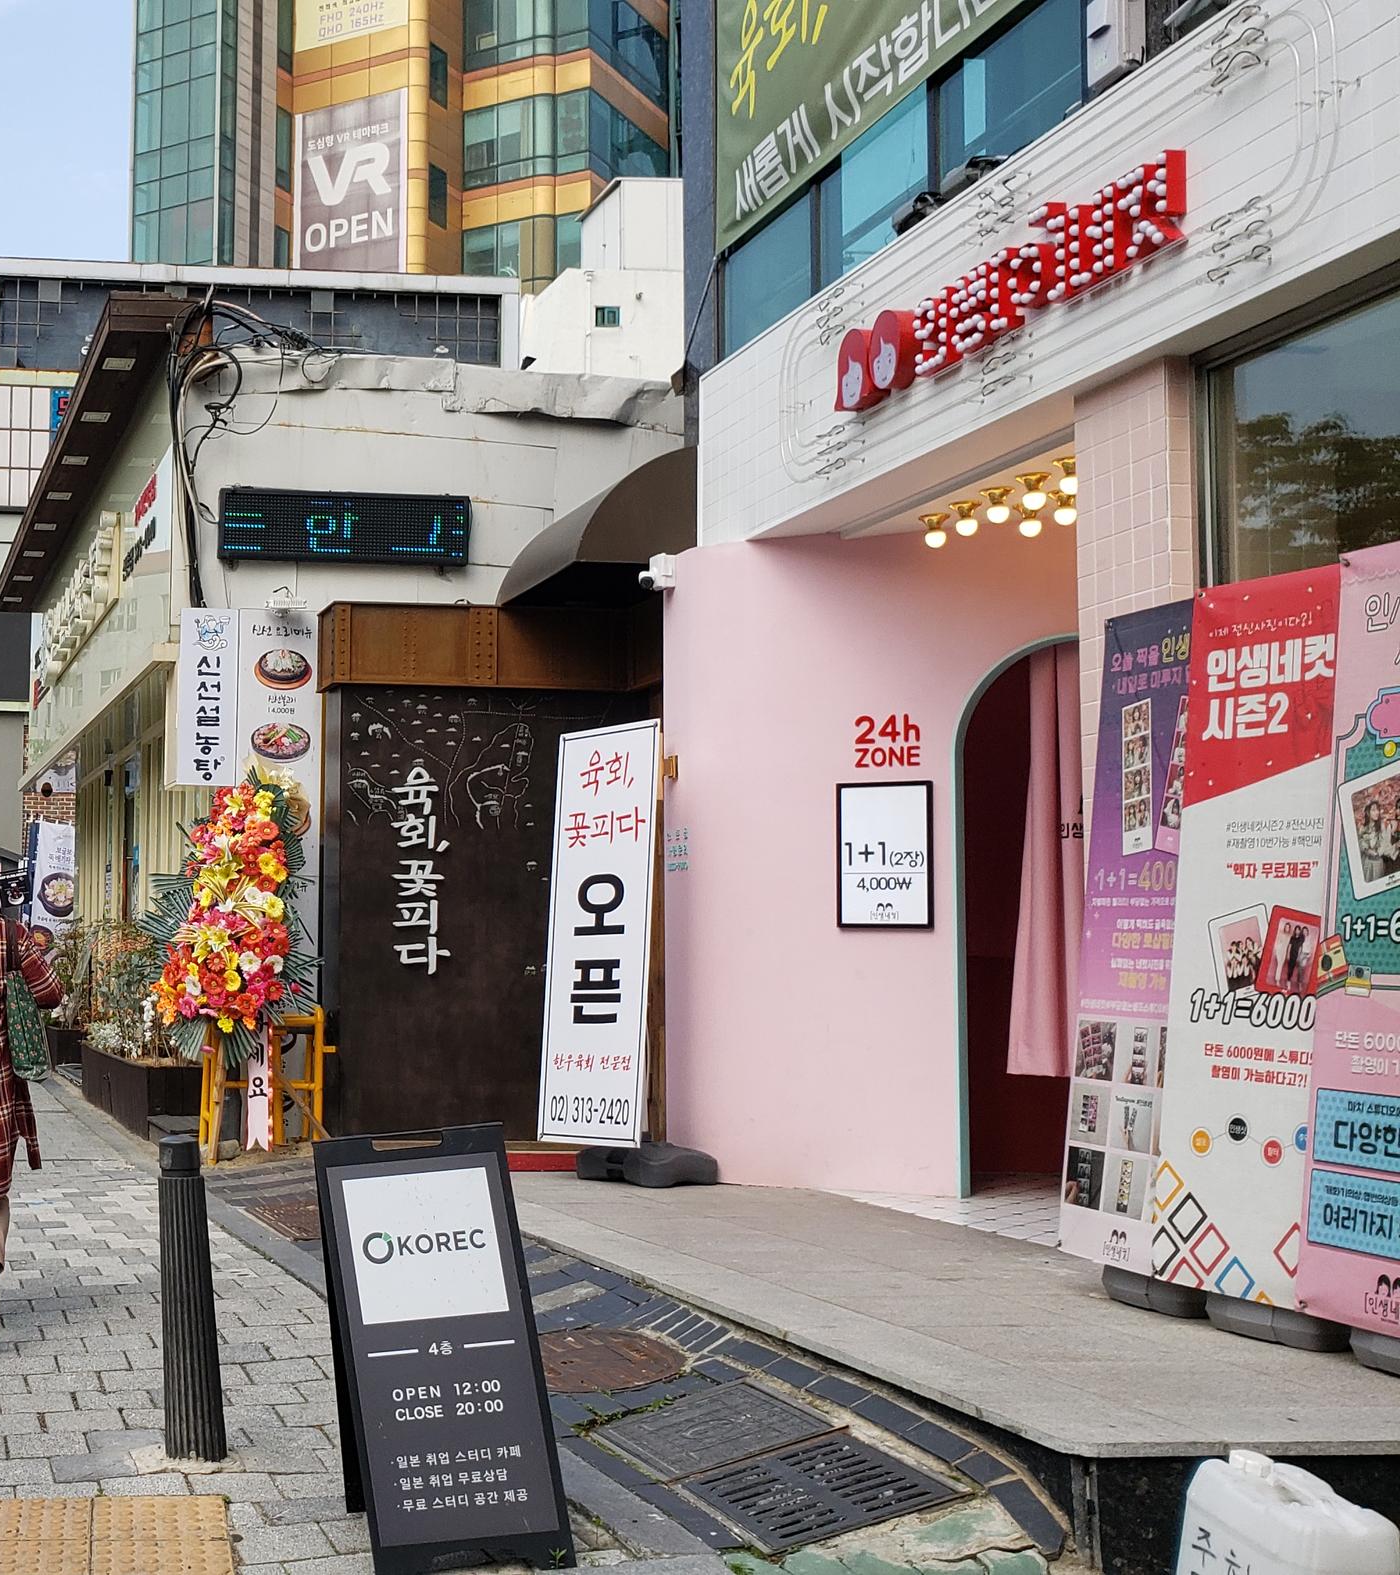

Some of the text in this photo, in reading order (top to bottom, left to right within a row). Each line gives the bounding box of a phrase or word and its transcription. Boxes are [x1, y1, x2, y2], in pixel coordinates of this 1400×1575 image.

[318, 14, 385, 37] QHD 165Hz
[320, 2, 385, 25] FHD 240Hz
[306, 122, 389, 152] 도심형 VR 테마파크
[307, 142, 392, 206] VR
[734, 103, 821, 222] 새롭게
[305, 207, 393, 252] OPEN
[912, 150, 1188, 378] 인생네컷
[252, 624, 273, 637] 신선
[1111, 651, 1134, 672] 오늘
[1206, 633, 1336, 693] 인생네컷
[193, 655, 223, 781] 신선설농탕
[1201, 692, 1290, 741] 시즌2
[854, 714, 921, 744] 24h
[854, 746, 921, 768] ZONE
[579, 750, 635, 797] 육회,
[564, 806, 647, 849] 꽃피다
[391, 766, 451, 976] 육회, 꽃피다
[570, 873, 625, 1024] 오픈
[1335, 1030, 1360, 1050] 단돈
[599, 1054, 632, 1072] 전문점
[1204, 1043, 1224, 1058] 단돈
[1226, 1045, 1275, 1063] 6000원에
[1211, 1064, 1308, 1088] 촬영이 가능하다고?!
[1351, 1056, 1390, 1077] 촬영이
[550, 1094, 630, 1127] 02) 313-2420
[1347, 1101, 1400, 1117] 마치 스튜디오
[1323, 1202, 1394, 1240] 여러가지
[1364, 1292, 1400, 1321] [인생네
[428, 1338, 453, 1356] 4층
[392, 1379, 501, 1402] OPEN 12:00
[395, 1399, 504, 1422] CLOSE 20:00
[426, 1451, 450, 1467] 취업
[455, 1447, 492, 1464] 스터디
[496, 1444, 522, 1460] 카페
[429, 1472, 454, 1488] 취업
[458, 1467, 509, 1486] 무료상담
[432, 1493, 470, 1510] 스터디
[474, 1490, 499, 1506] 공간
[504, 1487, 529, 1504] 제공
